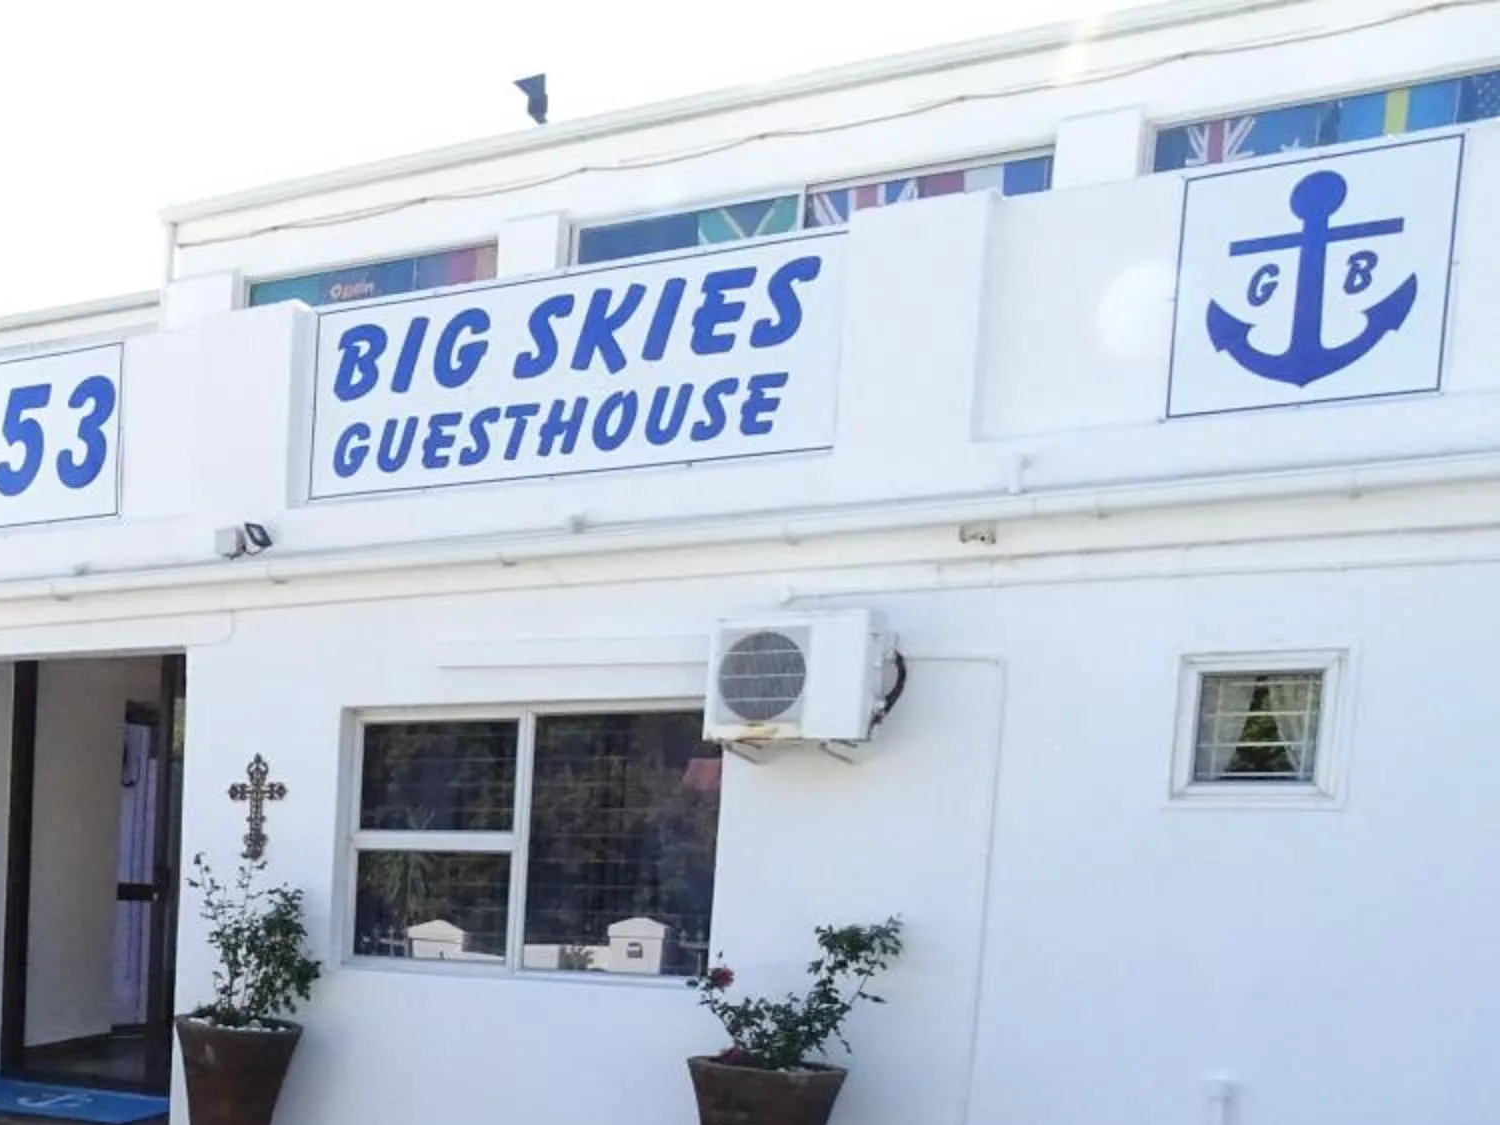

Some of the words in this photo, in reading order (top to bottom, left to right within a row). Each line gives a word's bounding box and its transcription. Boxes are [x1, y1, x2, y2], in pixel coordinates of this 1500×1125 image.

[333, 307, 490, 402] BIG
[513, 255, 822, 379] SKIES
[1247, 263, 1280, 307] G
[1343, 250, 1379, 295] B
[333, 372, 789, 478] GUESTHOUSE
